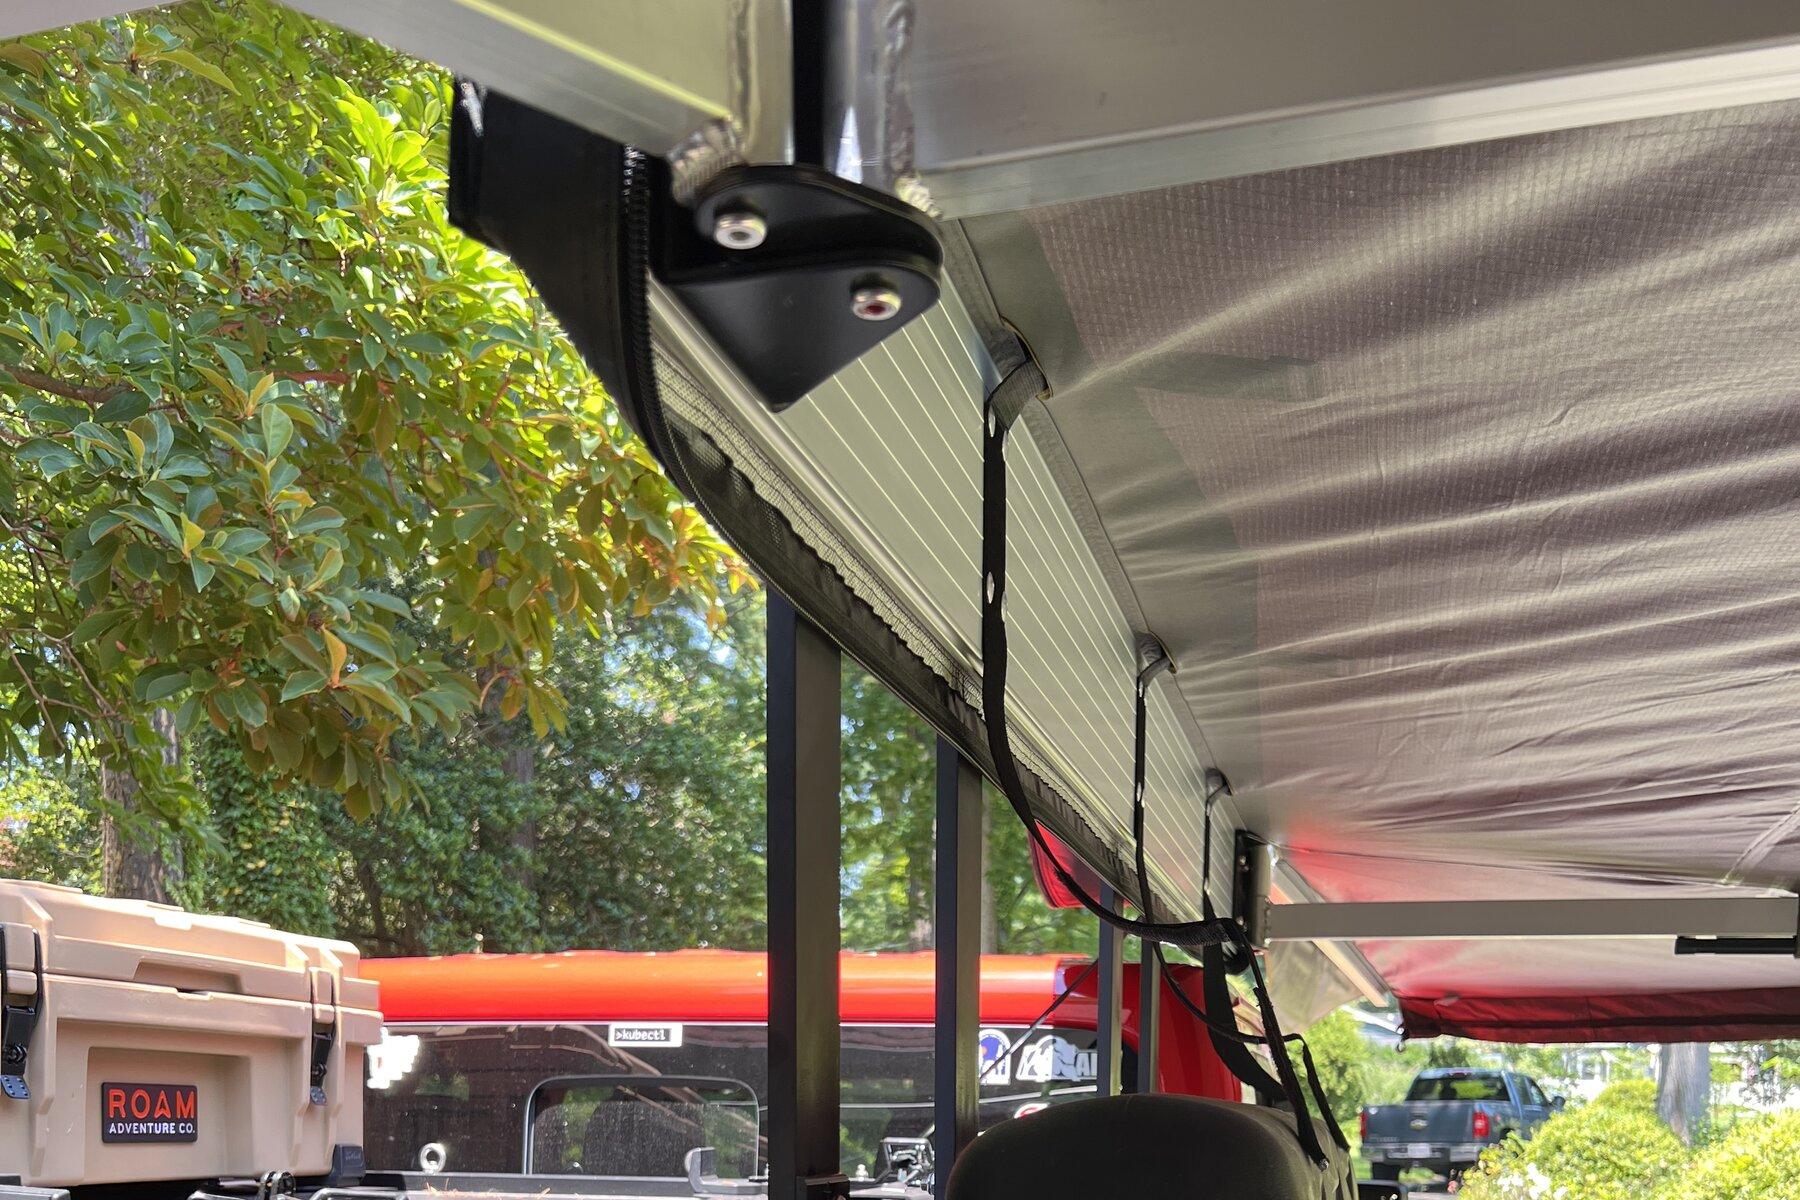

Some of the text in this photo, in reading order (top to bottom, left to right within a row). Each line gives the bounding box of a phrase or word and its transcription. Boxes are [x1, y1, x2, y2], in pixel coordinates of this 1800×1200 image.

[108, 1088, 196, 1119] ROAM
[109, 1122, 196, 1134] ADVENTURE CO.
